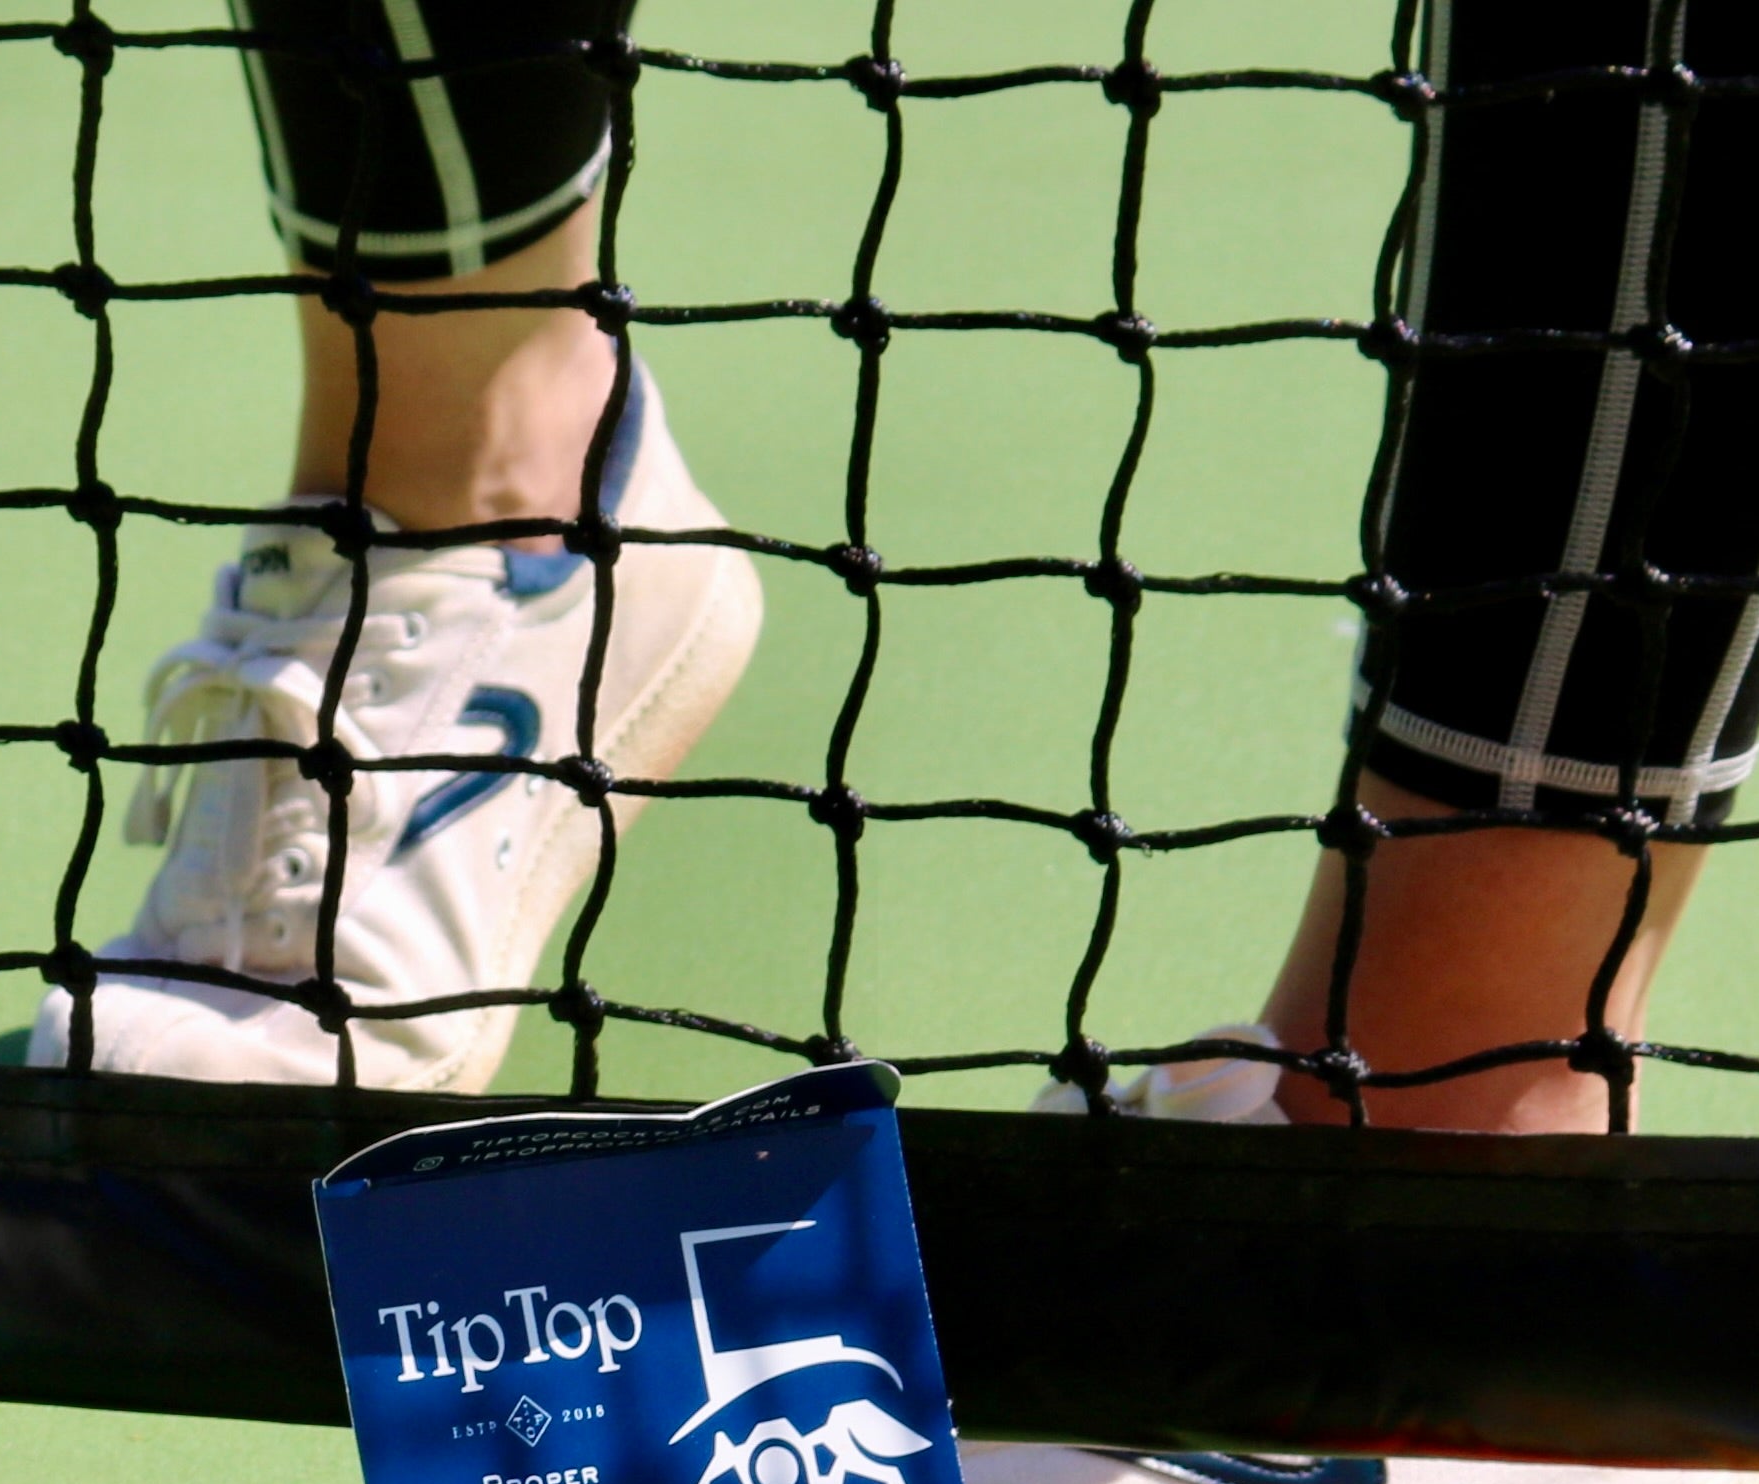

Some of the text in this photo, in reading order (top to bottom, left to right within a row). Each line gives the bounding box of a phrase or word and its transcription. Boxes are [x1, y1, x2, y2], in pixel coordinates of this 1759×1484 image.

[378, 1285, 642, 1393] Tip Top
[562, 1404, 605, 1422] 2018
